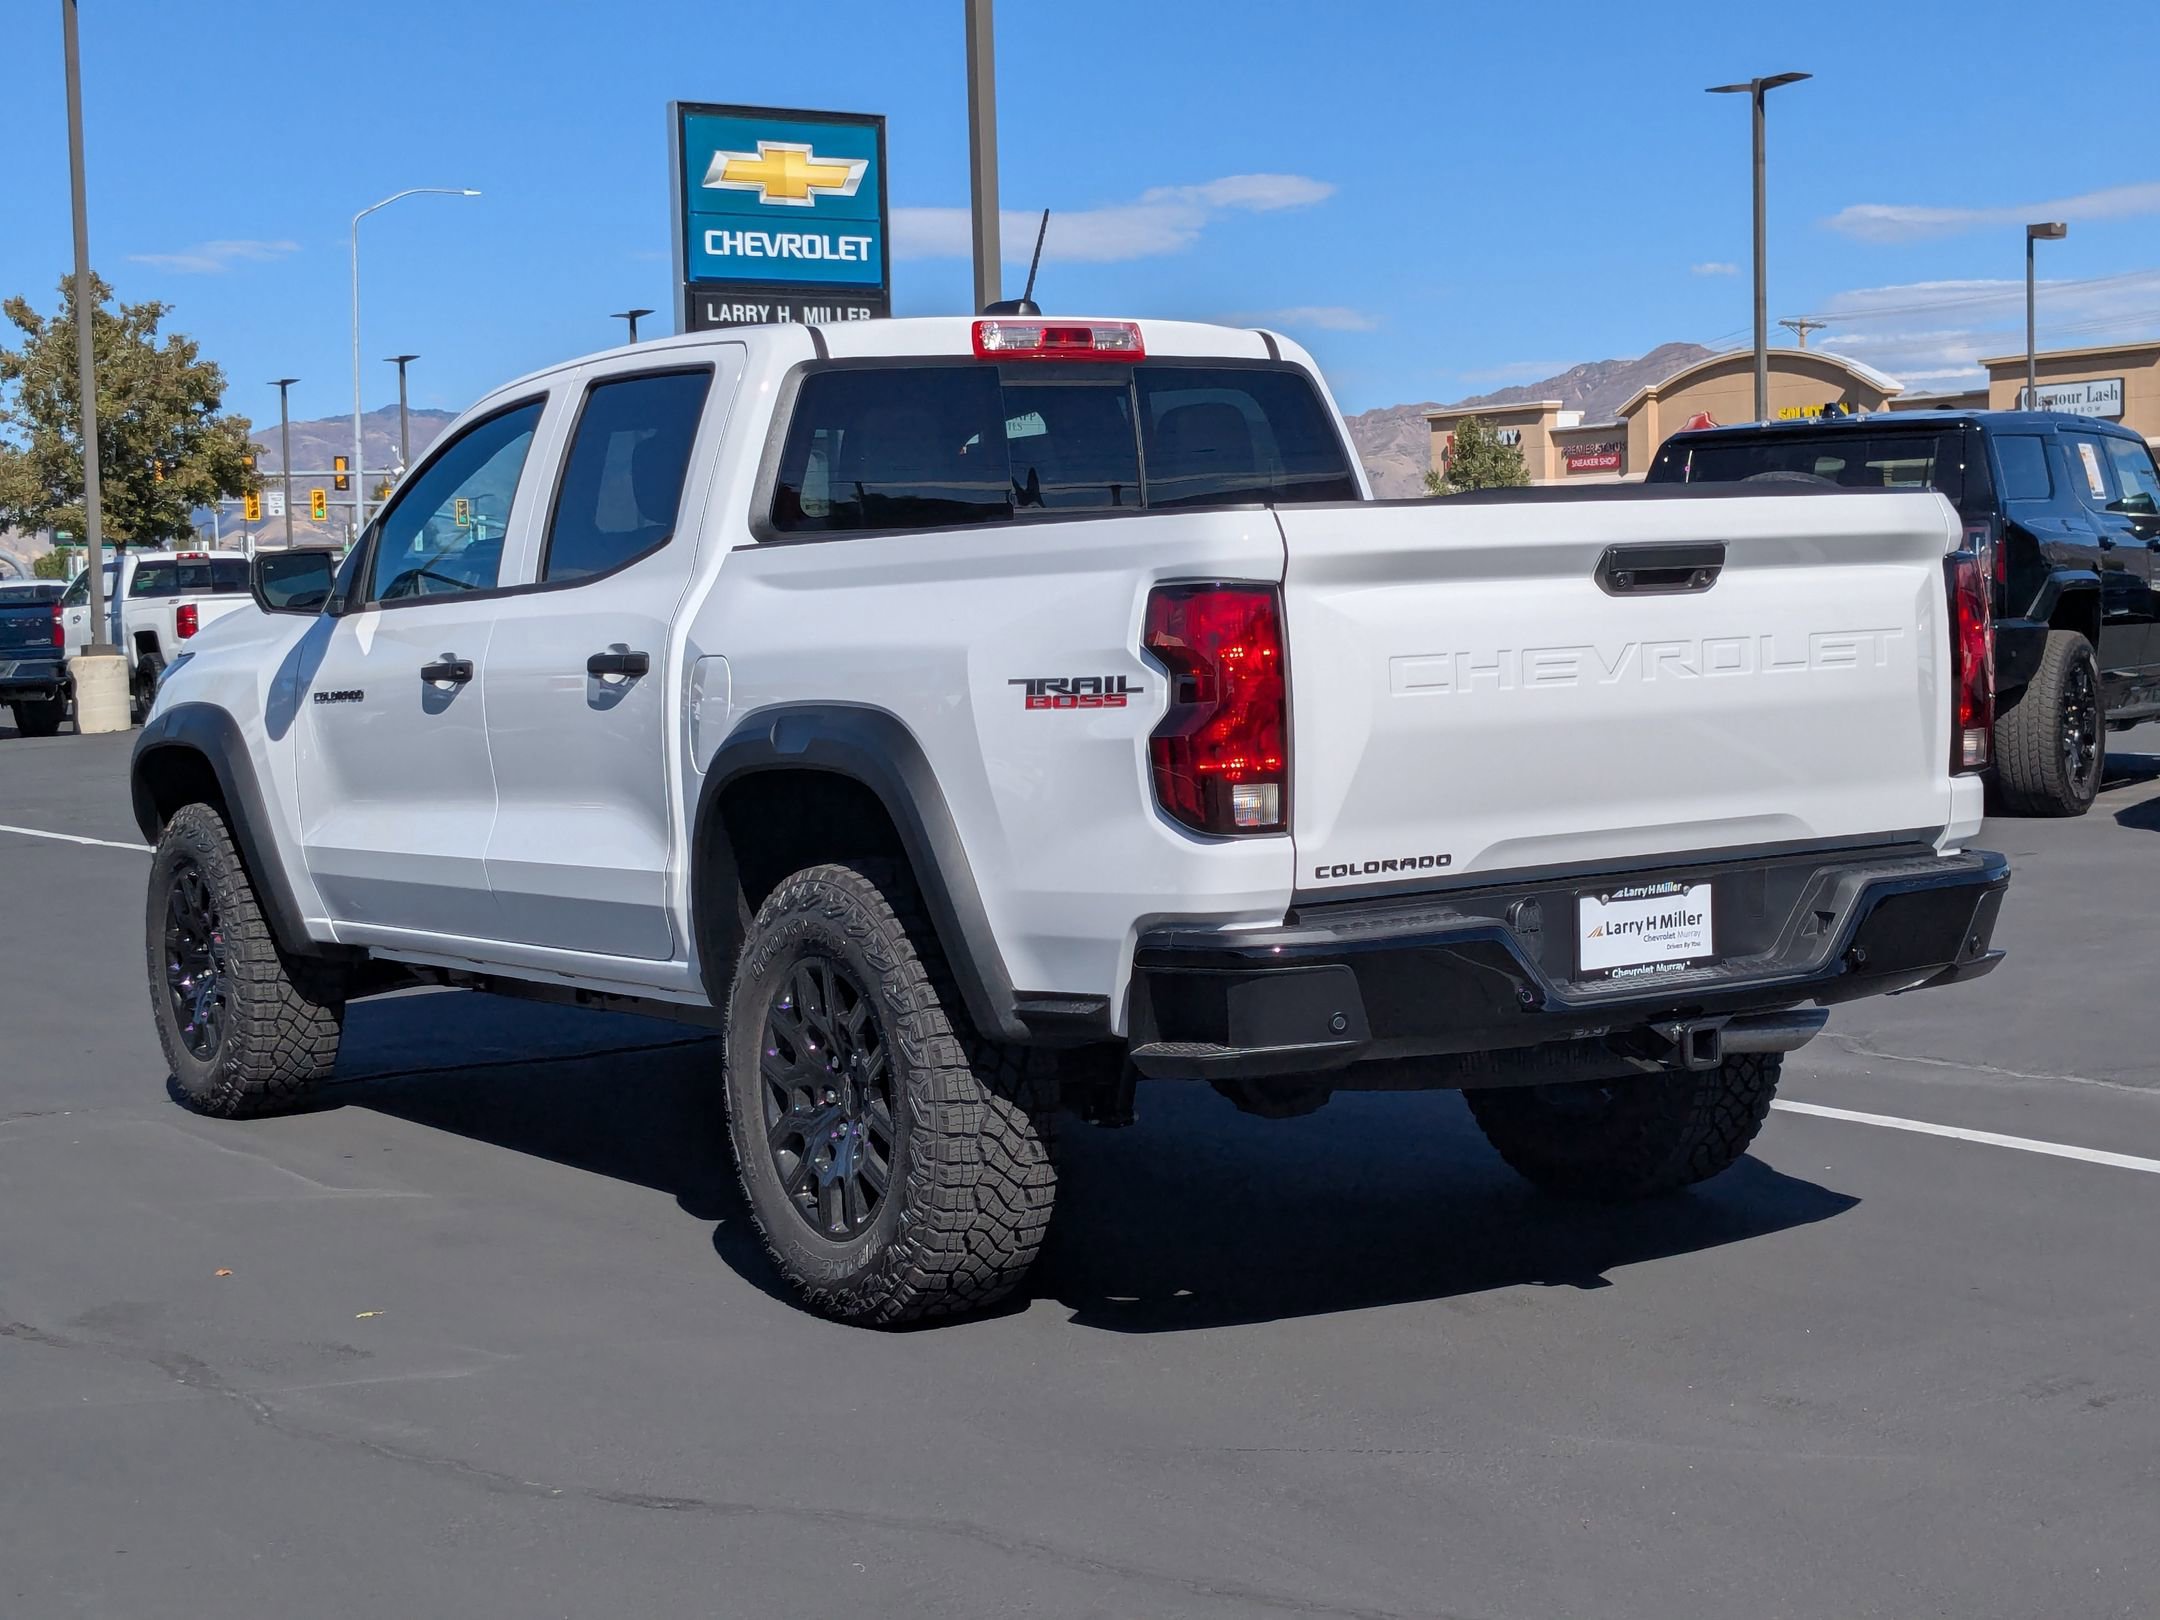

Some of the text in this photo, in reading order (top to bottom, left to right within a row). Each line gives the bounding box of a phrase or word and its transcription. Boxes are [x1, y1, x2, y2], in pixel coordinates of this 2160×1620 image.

[704, 230, 873, 261] CHEVROLET
[707, 303, 770, 323] LARRY
[2086, 384, 2118, 403] Lash
[1572, 456, 1616, 467] SNEAKER SHOP
[1389, 627, 1904, 697] CHEVROLET
[1008, 675, 1144, 696] TRAIL
[1025, 693, 1127, 710] BOSS
[1315, 853, 1452, 879] COLORADO
[1624, 881, 1682, 898] Larry H Miller
[1606, 910, 1702, 936] Larry H Miller
[1643, 930, 1702, 943] Chevrolet Murray
[1612, 962, 1686, 978] Chevrolet Murray
